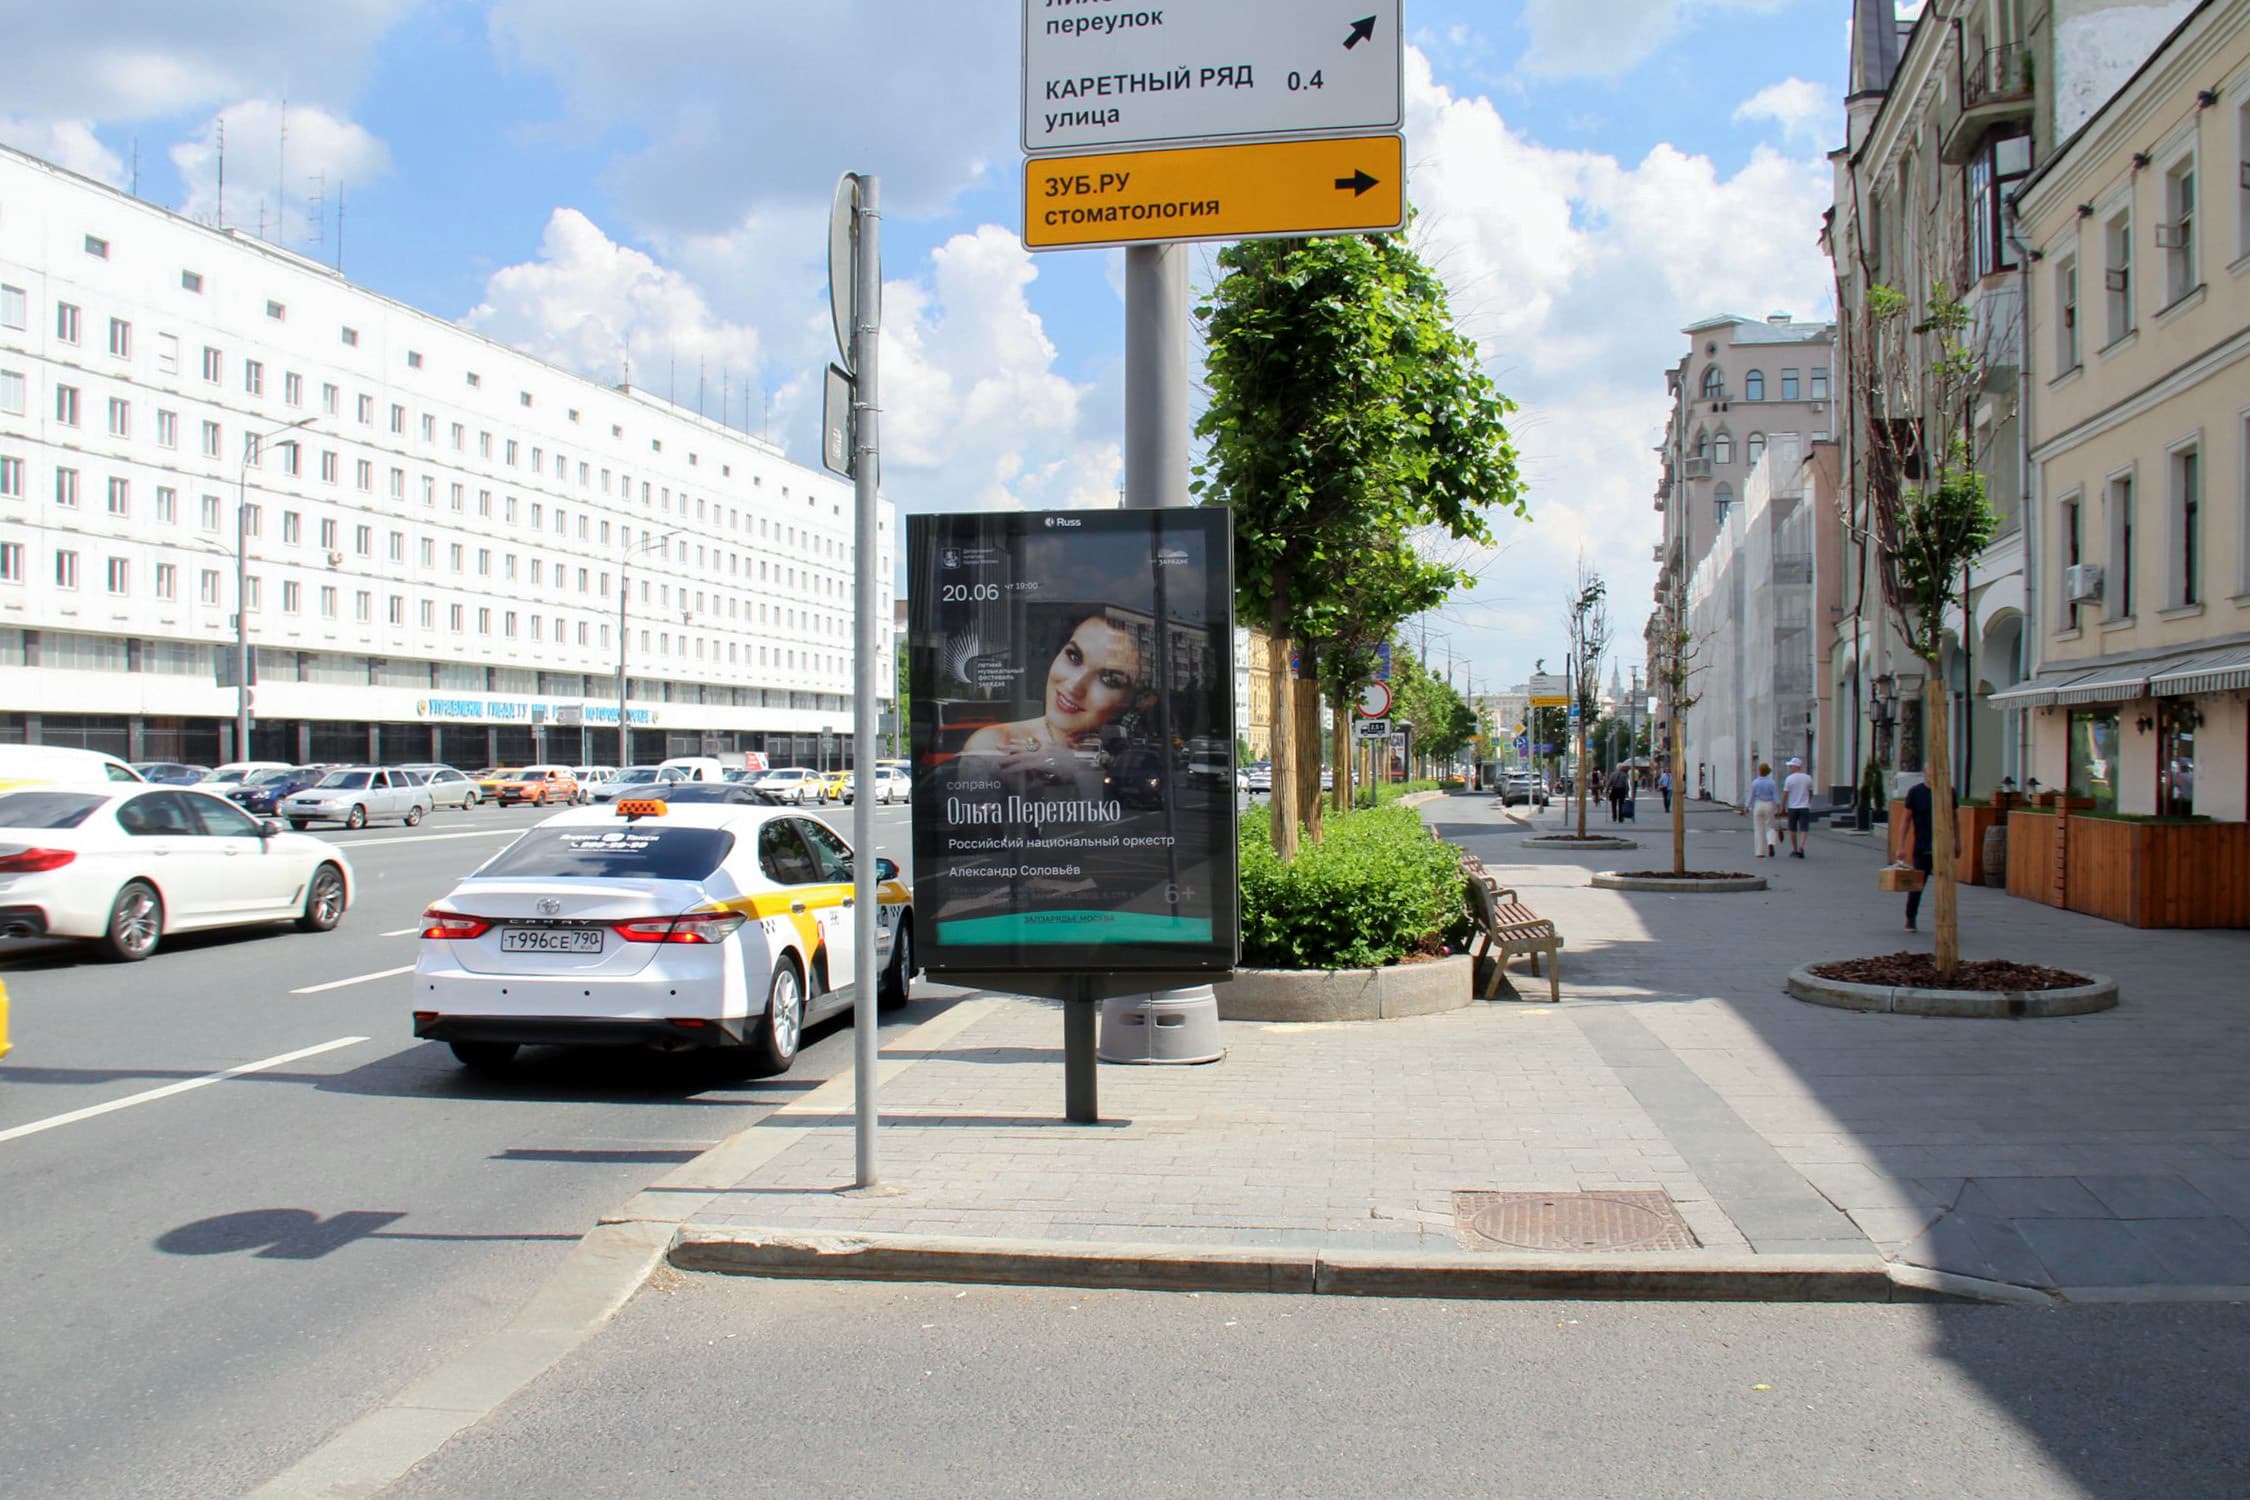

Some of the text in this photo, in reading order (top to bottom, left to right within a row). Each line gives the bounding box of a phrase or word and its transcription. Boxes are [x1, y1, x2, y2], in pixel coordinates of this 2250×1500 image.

[1046, 10, 1164, 36] переулок
[1046, 65, 1324, 100] КАРЕТНЫЙ РЯД 0.4
[1045, 108, 1120, 133] улица
[1045, 172, 1131, 197] ЗУБ.РУ
[1044, 200, 1220, 226] стоматология
[1056, 517, 1082, 528] Russ
[942, 583, 999, 602] 20.06
[1015, 582, 1039, 590] 19:00
[946, 779, 1002, 793] сопрано
[946, 795, 1122, 829] Ольга Перетятько
[948, 834, 1176, 849] Российский национальный оркестр
[948, 863, 1082, 878] Александр Соловьёв
[1164, 883, 1196, 904] 6+
